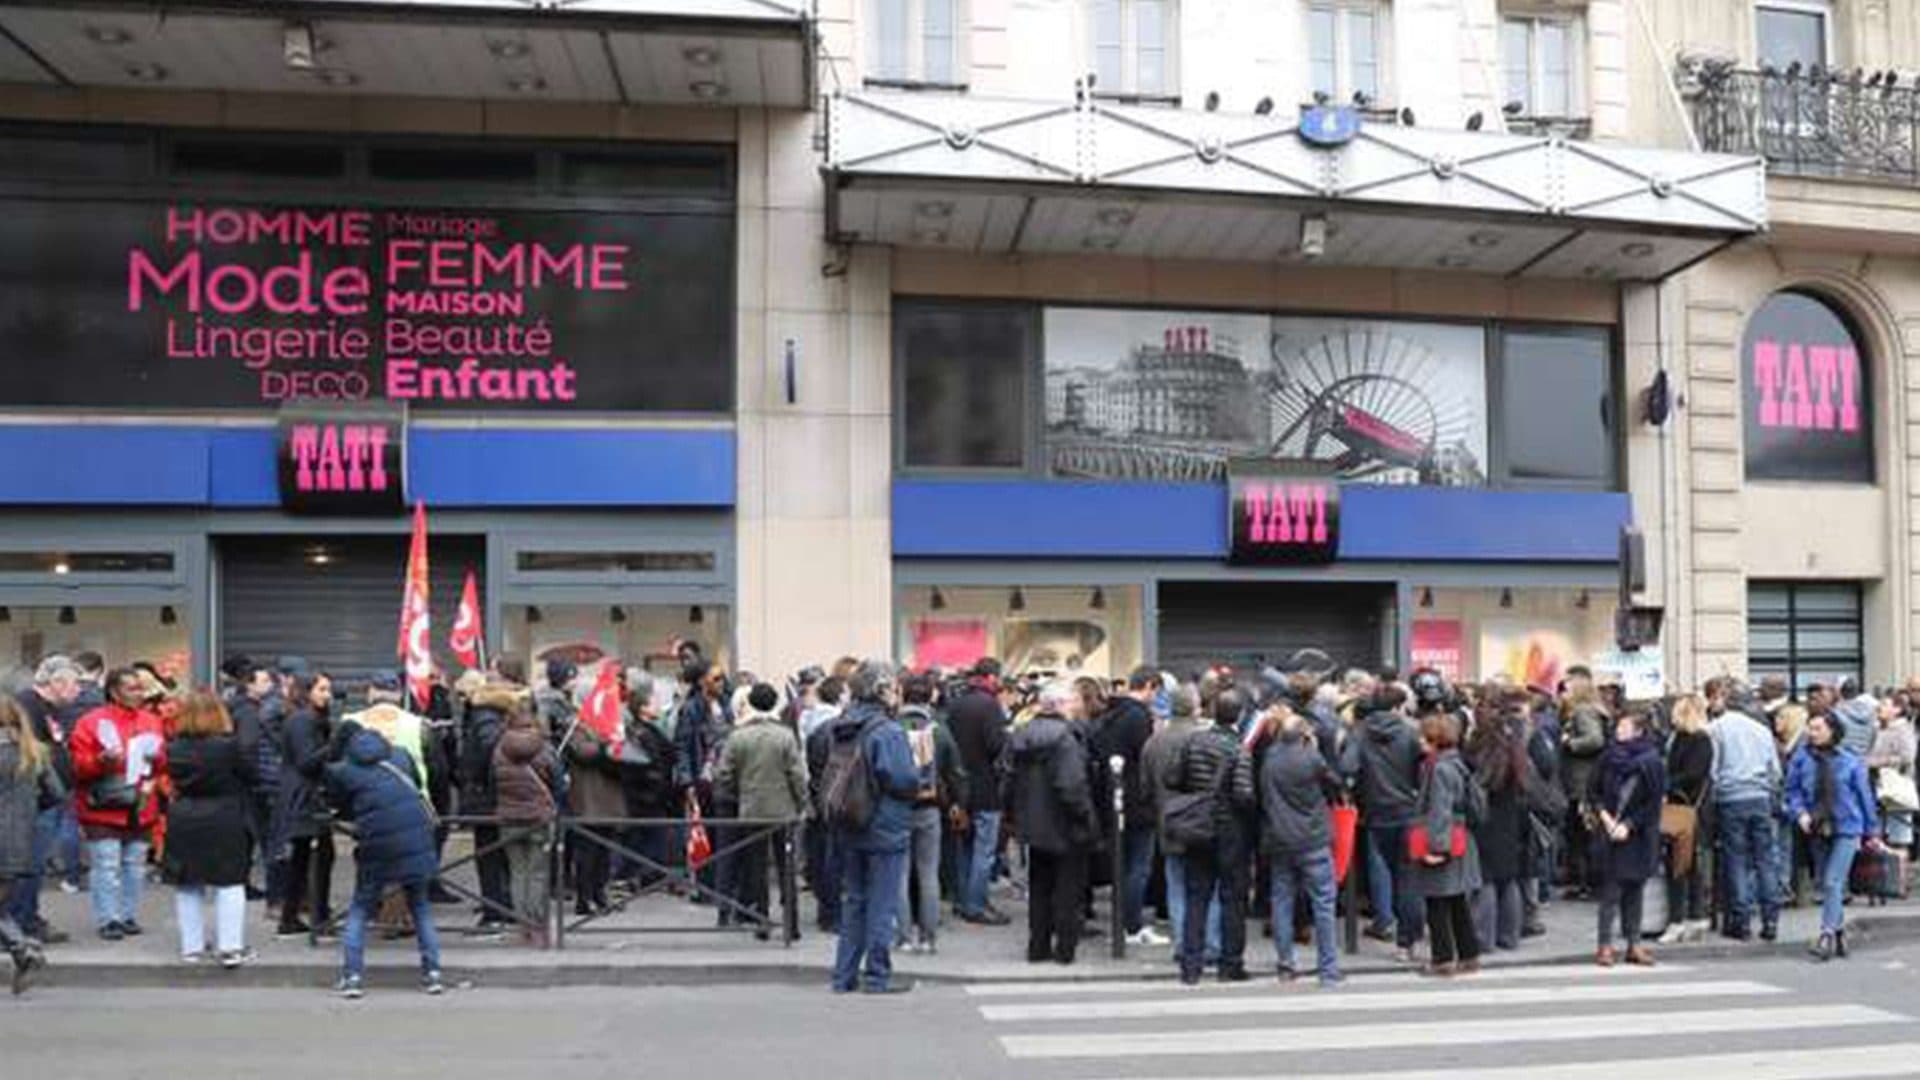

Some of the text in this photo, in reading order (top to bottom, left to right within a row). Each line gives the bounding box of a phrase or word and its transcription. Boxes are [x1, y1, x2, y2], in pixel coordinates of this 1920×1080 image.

[167, 209, 371, 245] HOMME
[387, 213, 496, 237] Mariage
[129, 250, 370, 315] Mode
[388, 241, 628, 290] FEMME
[387, 290, 522, 316] MAISON
[168, 319, 370, 367] Lingerie
[386, 319, 552, 356] Beauté
[386, 360, 576, 400] Enfant
[1754, 341, 1859, 431] TATI
[292, 424, 386, 490] TATI
[1246, 484, 1327, 543] TATI
